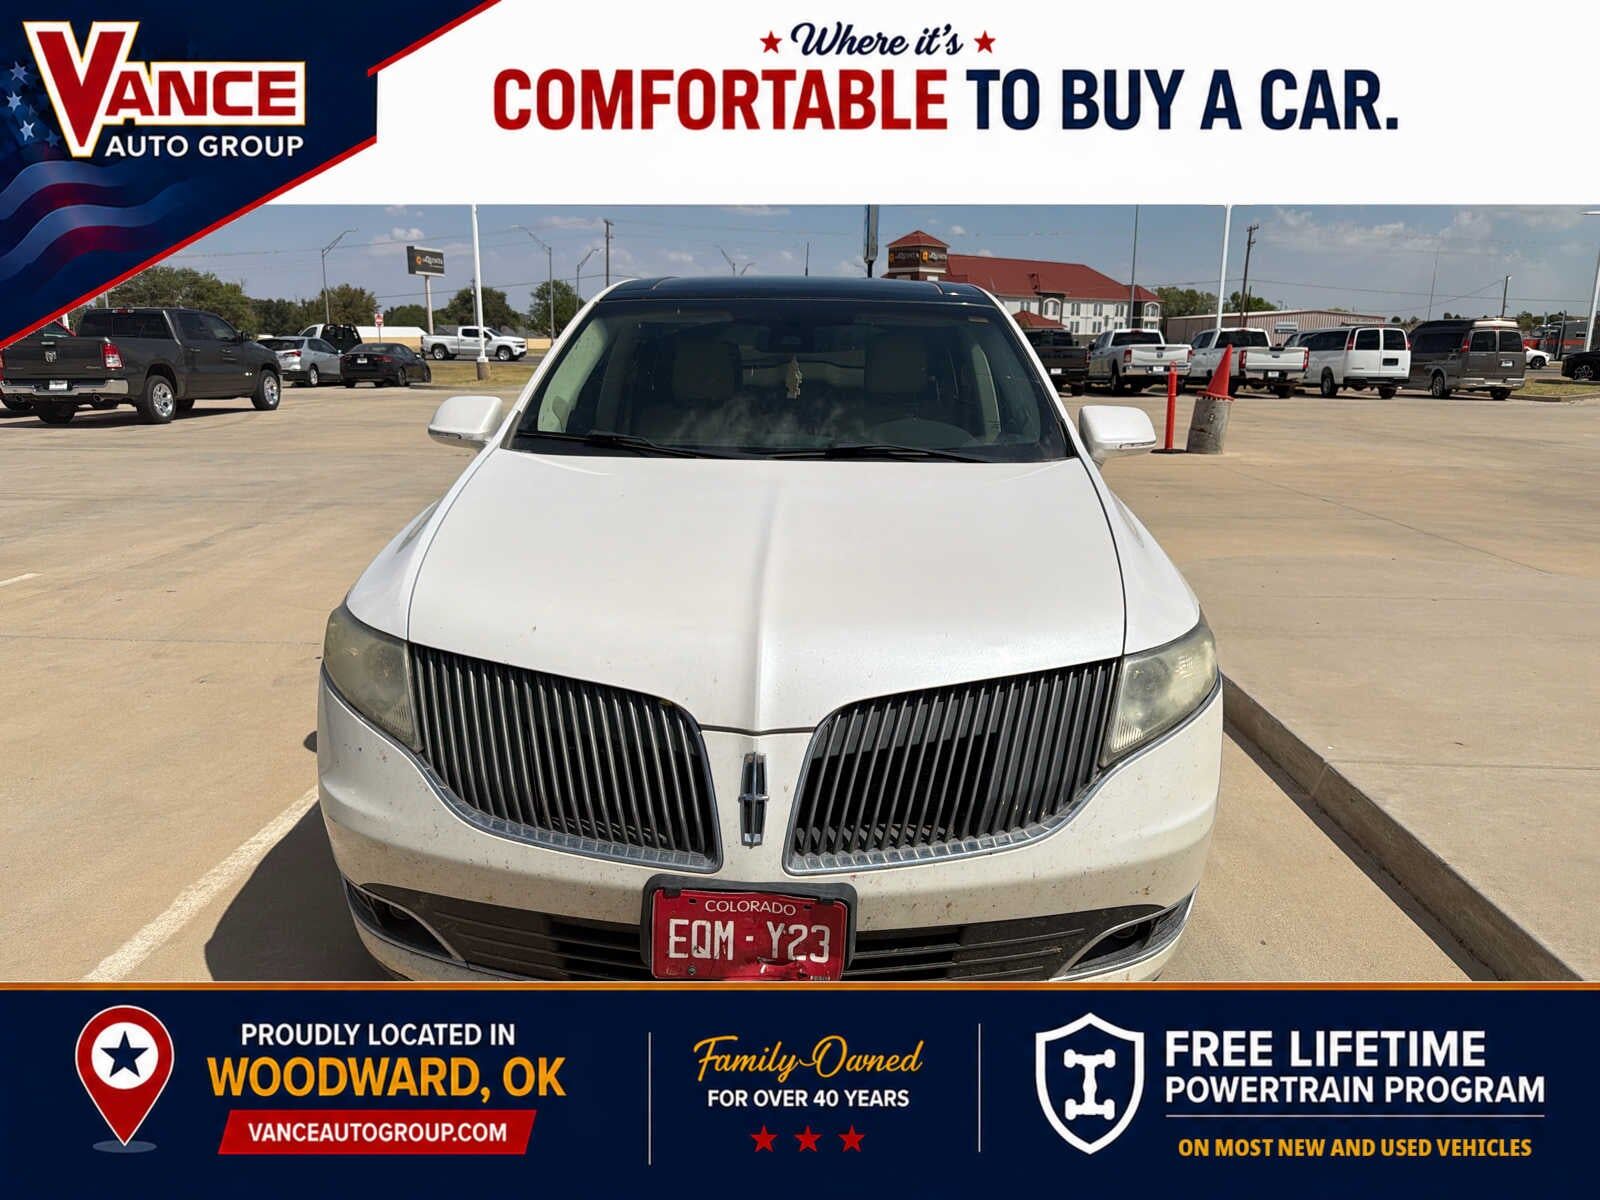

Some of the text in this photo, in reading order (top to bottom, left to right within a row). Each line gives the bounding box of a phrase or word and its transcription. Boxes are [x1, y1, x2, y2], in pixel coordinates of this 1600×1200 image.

[704, 899, 797, 917] COLORADO
[667, 917, 735, 961] EQM
[766, 921, 831, 963] Y23
